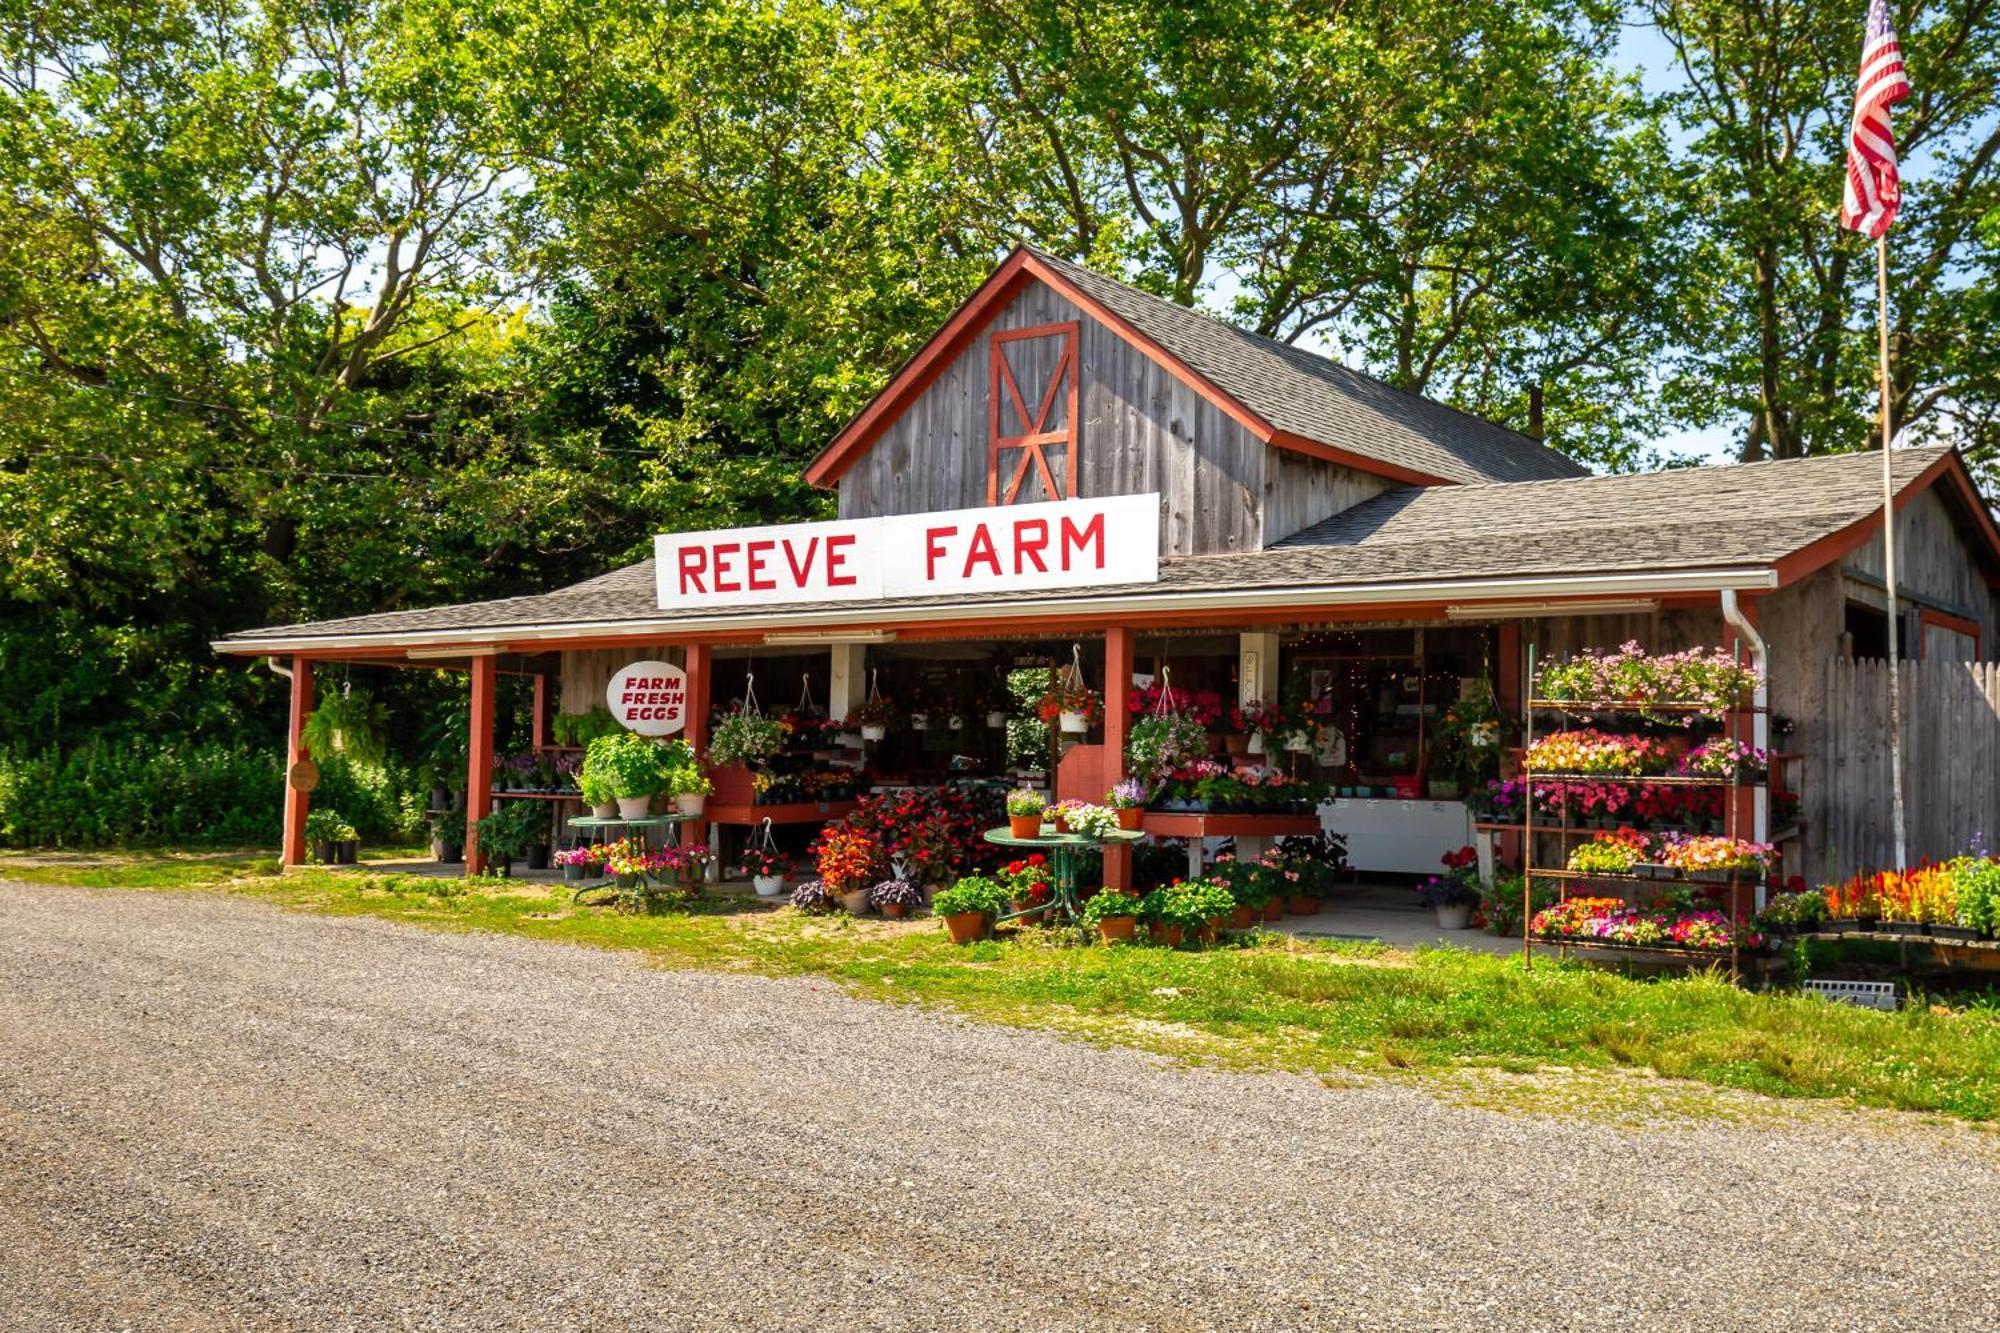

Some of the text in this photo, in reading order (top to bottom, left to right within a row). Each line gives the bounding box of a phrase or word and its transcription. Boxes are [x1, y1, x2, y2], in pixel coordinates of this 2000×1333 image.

[678, 512, 1105, 595] REEVE FARM
[625, 677, 681, 690] FARM
[621, 692, 685, 705] FRESH
[626, 707, 679, 721] EGGS
